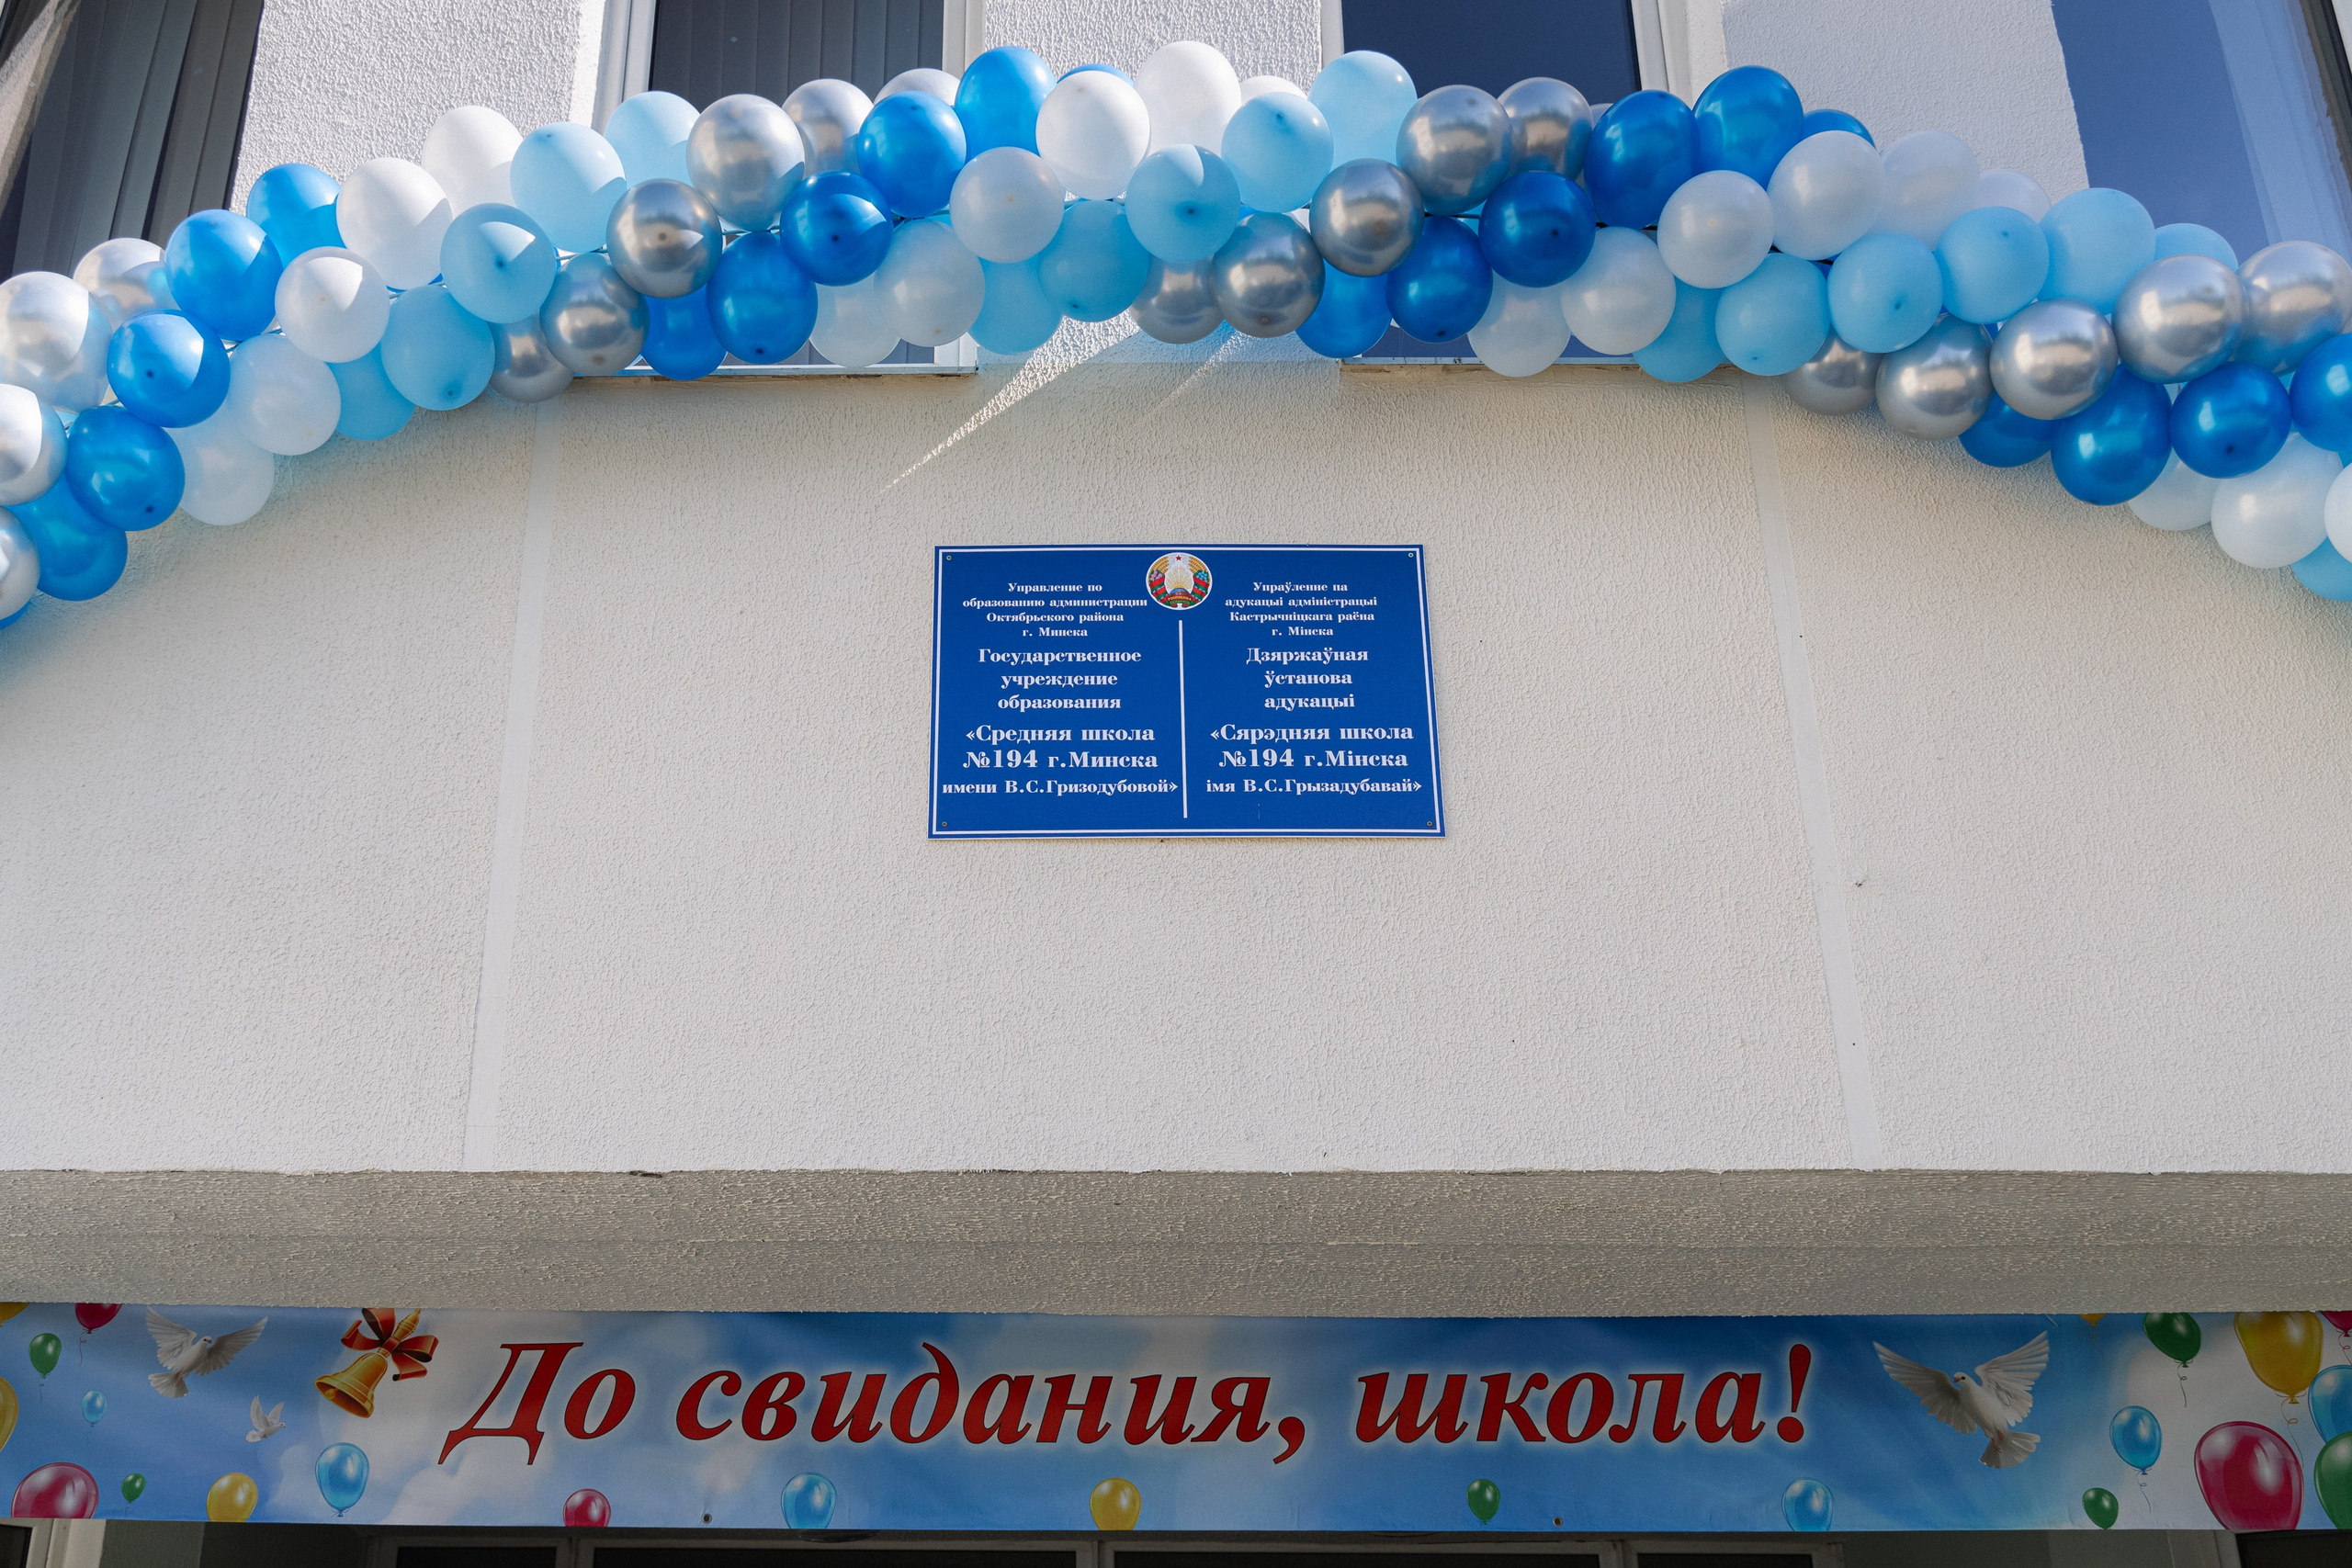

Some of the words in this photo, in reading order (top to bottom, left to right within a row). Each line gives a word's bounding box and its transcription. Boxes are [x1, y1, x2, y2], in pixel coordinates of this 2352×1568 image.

[1008, 582, 1083, 594] Управление
[1252, 581, 1329, 593] Упраўленне
[962, 597, 1046, 610] образованию
[1049, 599, 1148, 609] администрации
[1225, 596, 1283, 609] адукацыі
[1287, 596, 1377, 609] адміністрацыі
[986, 612, 1075, 625] Октябрьского
[1079, 612, 1125, 625] района
[1229, 611, 1333, 624] Кастрычніцкага
[1338, 611, 1375, 624] раёна
[1038, 626, 1088, 637] Минска
[1272, 628, 1283, 637] г.
[1288, 626, 1334, 636] Мінска
[978, 649, 1142, 666] Государственное
[1246, 647, 1368, 665] Дзяржаўная
[1001, 673, 1118, 690] учреждение
[1264, 670, 1353, 689] ўстанова
[997, 694, 1121, 713] образования
[1264, 693, 1355, 712] адукацыі
[966, 725, 1072, 744] «Средняя
[1081, 728, 1156, 741] школа
[1210, 724, 1330, 745] «Сярэдняя
[1339, 726, 1415, 739] школа
[962, 749, 1038, 769] №194
[1047, 751, 1159, 768] г.Минска
[1218, 748, 1295, 768] №194
[1304, 750, 1408, 767] г.Мінска
[942, 784, 997, 794] имени
[1004, 778, 1179, 796] В.С.Гризодубовой»
[1206, 779, 1236, 793] імя
[1243, 777, 1422, 795] В.С.Грызадубавай»
[437, 1340, 638, 1466] До
[675, 1341, 1306, 1466] свидания,
[1354, 1343, 1813, 1444] школа!
